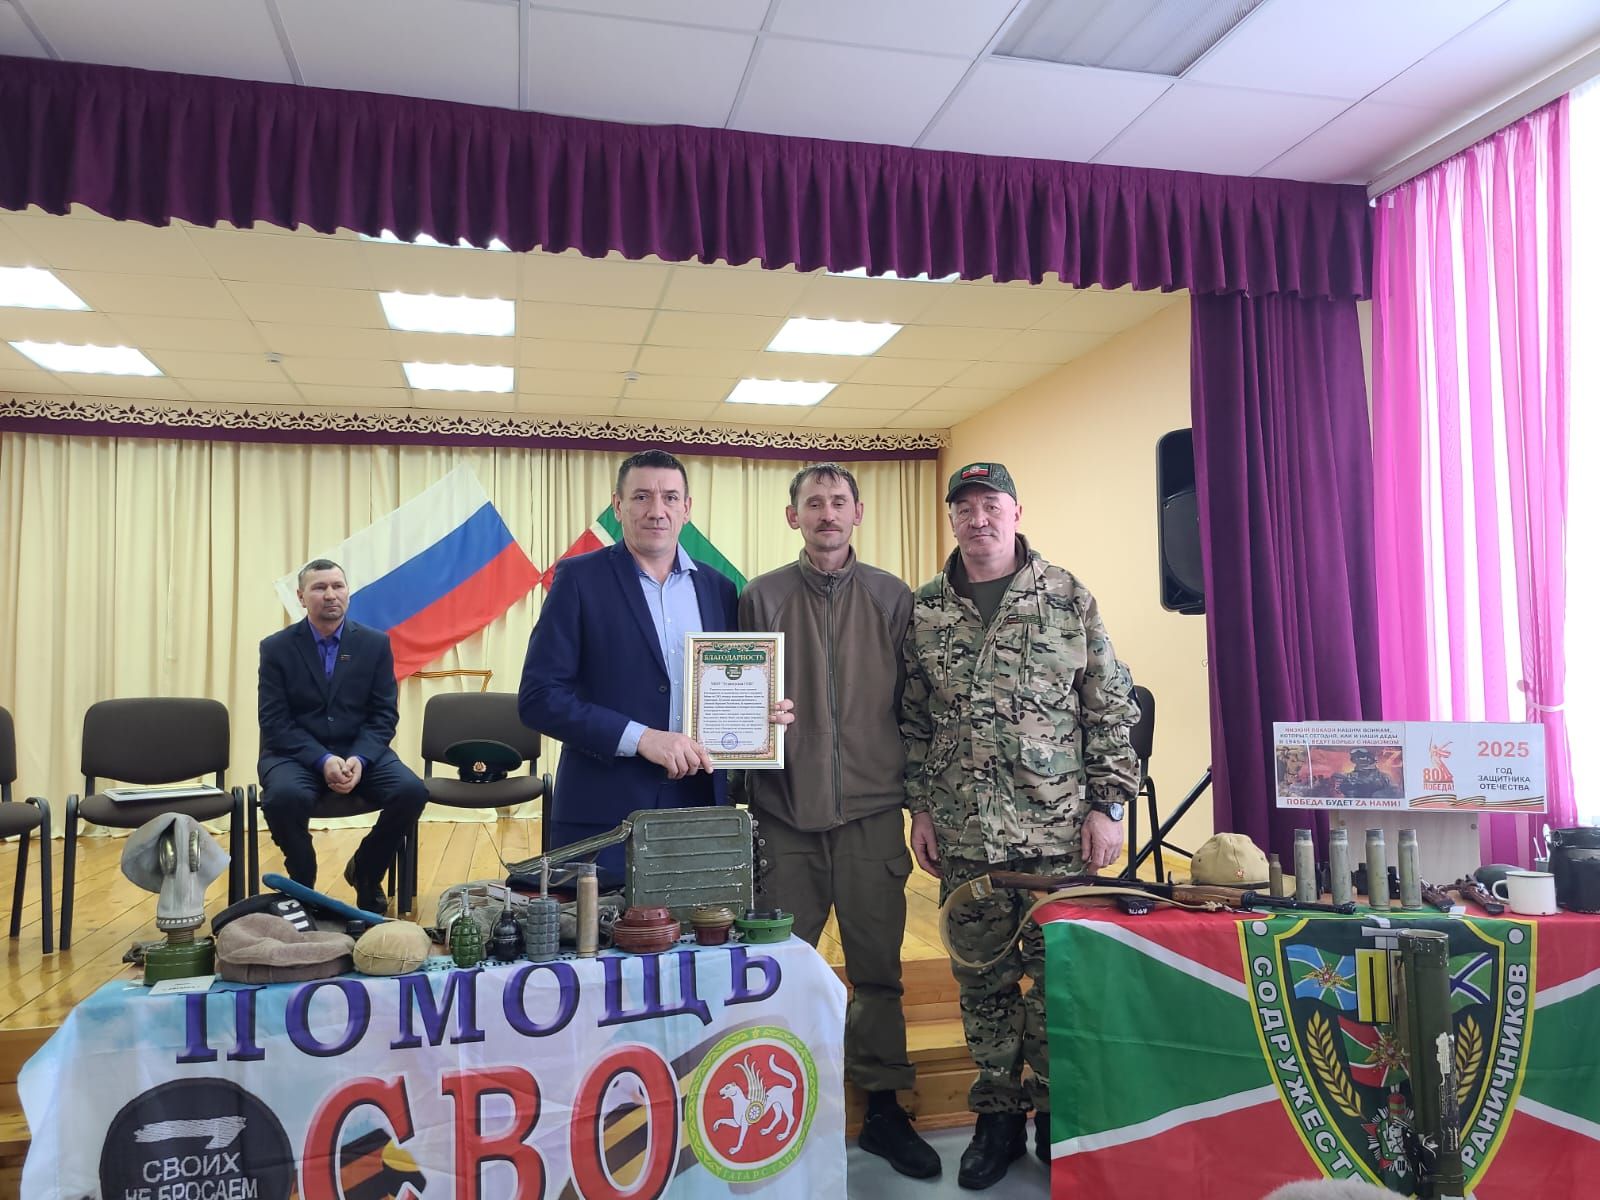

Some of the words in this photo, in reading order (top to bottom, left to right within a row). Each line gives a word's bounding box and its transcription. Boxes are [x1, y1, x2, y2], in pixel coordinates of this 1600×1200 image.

[1477, 740, 1529, 758] 2025
[1423, 768, 1441, 781] 80
[1478, 775, 1531, 783] ЗАЩИТНИКА
[1495, 767, 1513, 775] ГОД
[1479, 783, 1530, 791] ОТЕЧЕСТВА
[1286, 798, 1323, 806] ПОБЕДА
[1325, 799, 1353, 807] БУДЕТ
[1369, 800, 1401, 808] НАМИ!
[175, 945, 782, 1064] ПОМОЩЬ
[1461, 963, 1528, 1181] РАНИЧНИКОВ
[302, 1044, 678, 1200] СВО
[142, 1152, 241, 1183] СВОИХ
[158, 1177, 258, 1200] БРОСАЕМ
